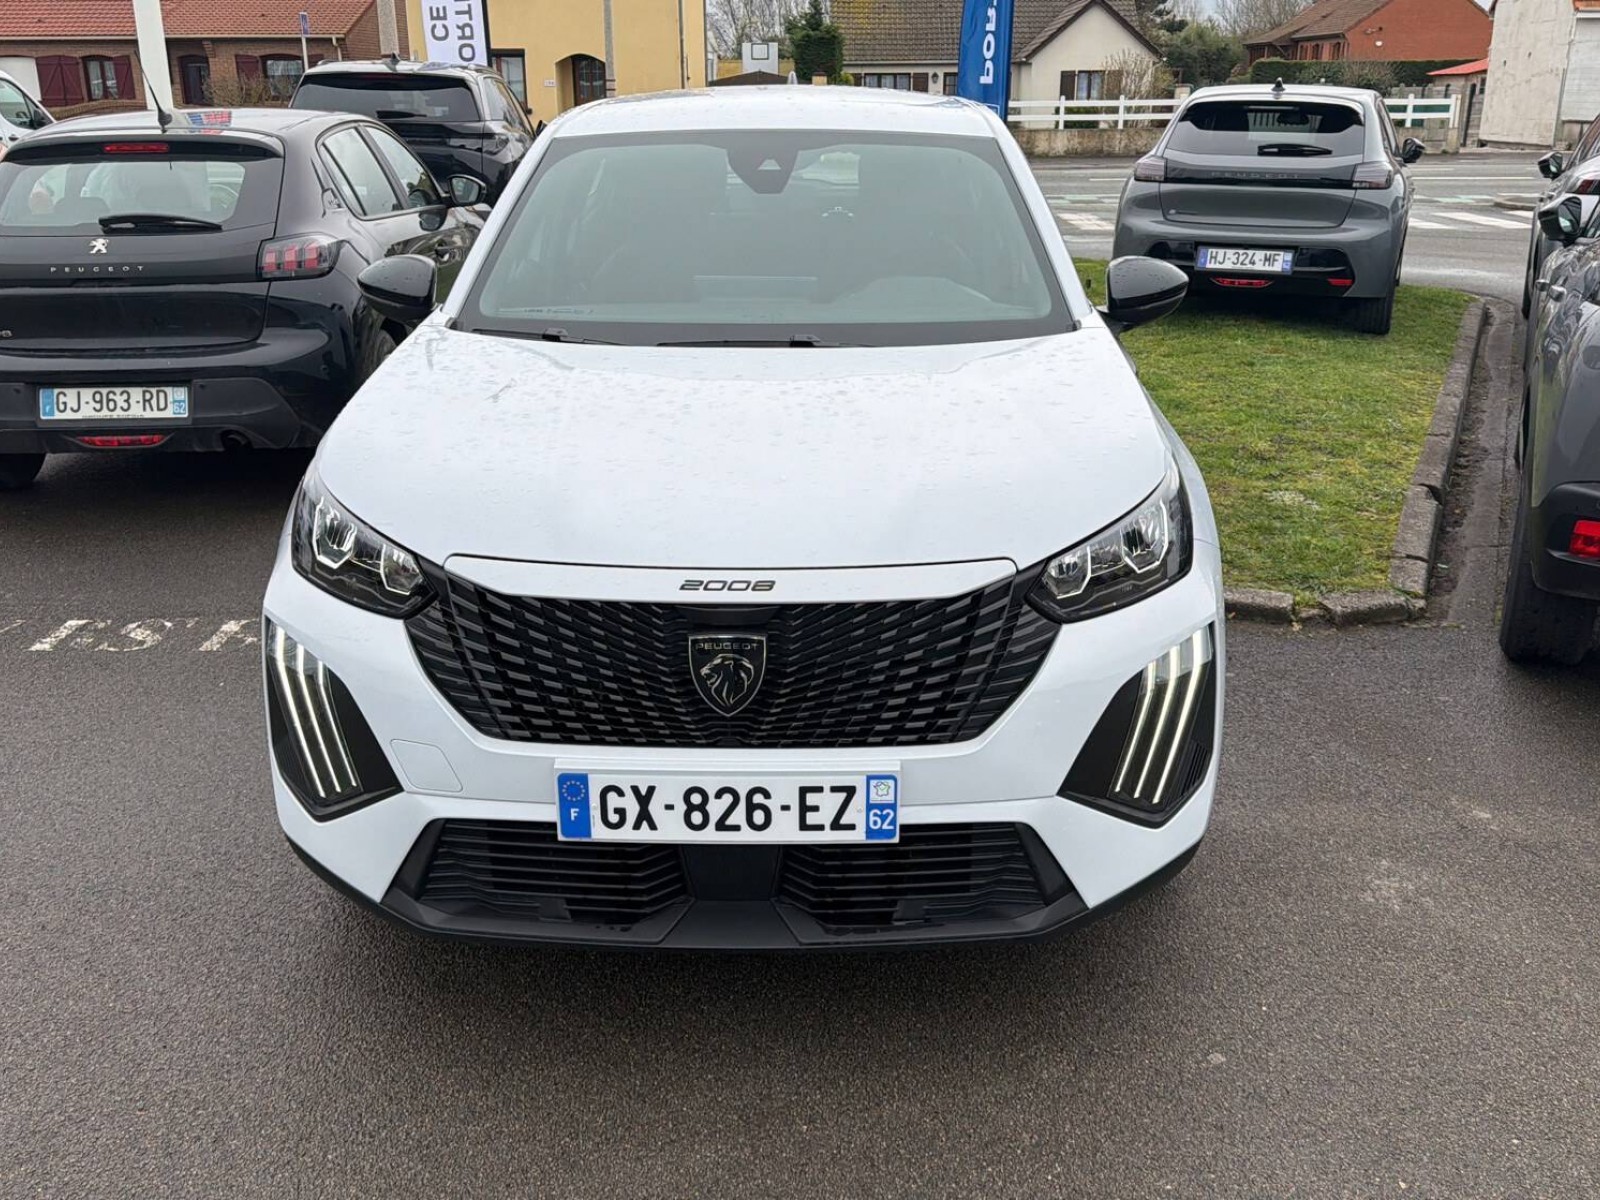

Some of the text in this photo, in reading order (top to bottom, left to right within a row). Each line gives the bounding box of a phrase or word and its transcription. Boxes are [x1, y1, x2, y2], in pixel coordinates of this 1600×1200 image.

[1208, 250, 1282, 268] HJ-324-MF
[50, 265, 144, 273] PEUGEOT
[55, 389, 168, 413] GJ-963-RD
[173, 402, 186, 413] 62
[679, 579, 776, 592] 2008
[695, 642, 760, 650] PEUGEOT
[570, 808, 579, 821] F
[599, 784, 857, 832] GX-826-EZ
[869, 809, 894, 830] 62
